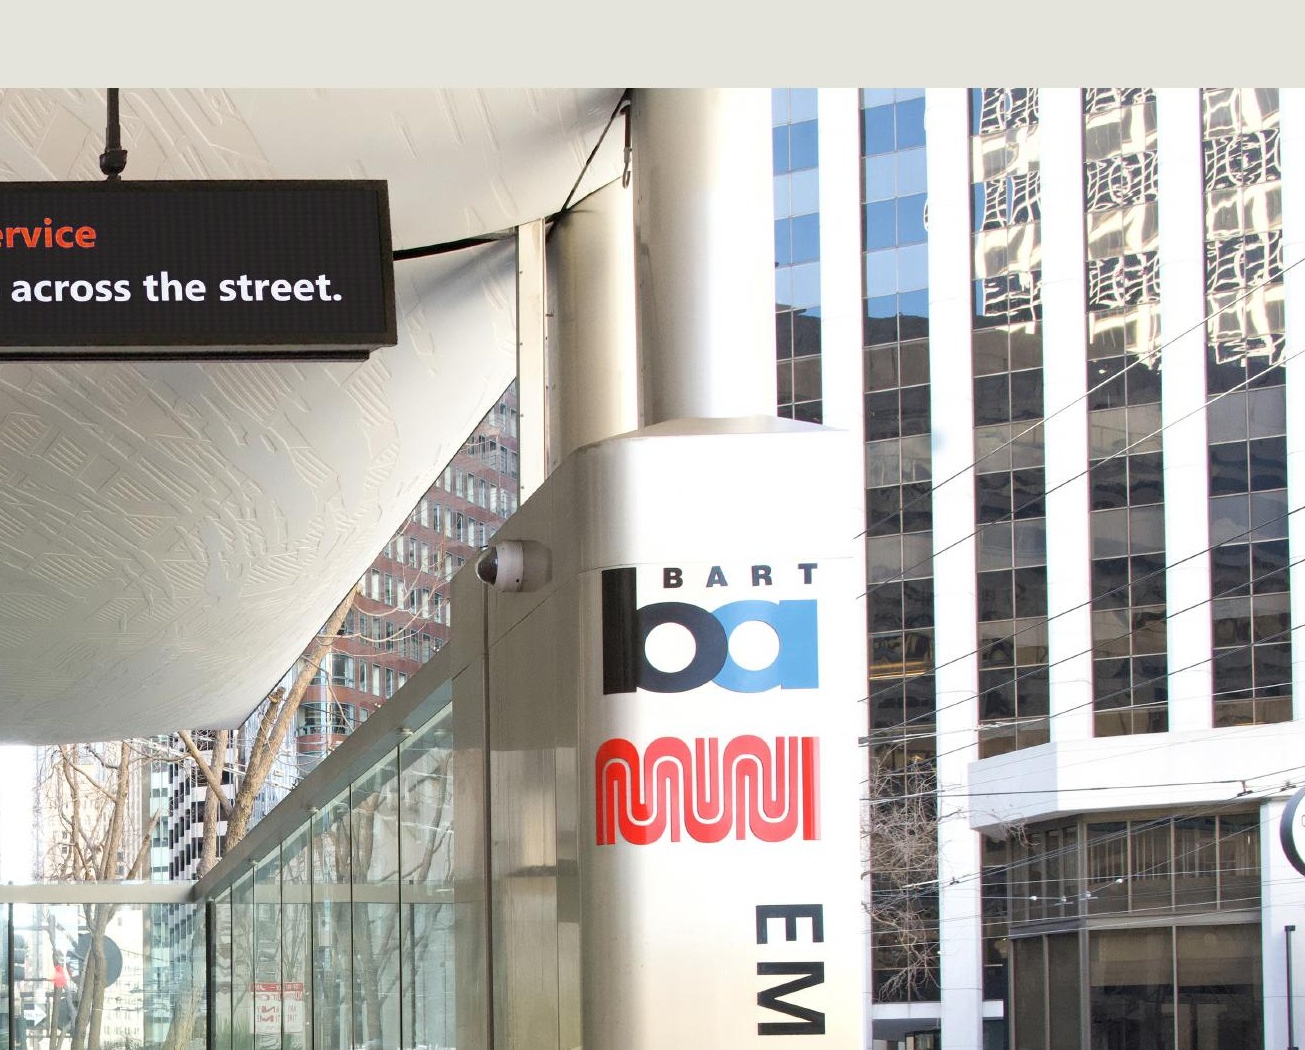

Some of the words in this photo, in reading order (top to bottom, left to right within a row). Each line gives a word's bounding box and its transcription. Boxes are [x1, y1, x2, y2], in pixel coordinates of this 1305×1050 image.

[10, 279, 133, 303] across
[142, 270, 208, 303] the
[219, 273, 343, 303] street.
[662, 563, 819, 589] BART
